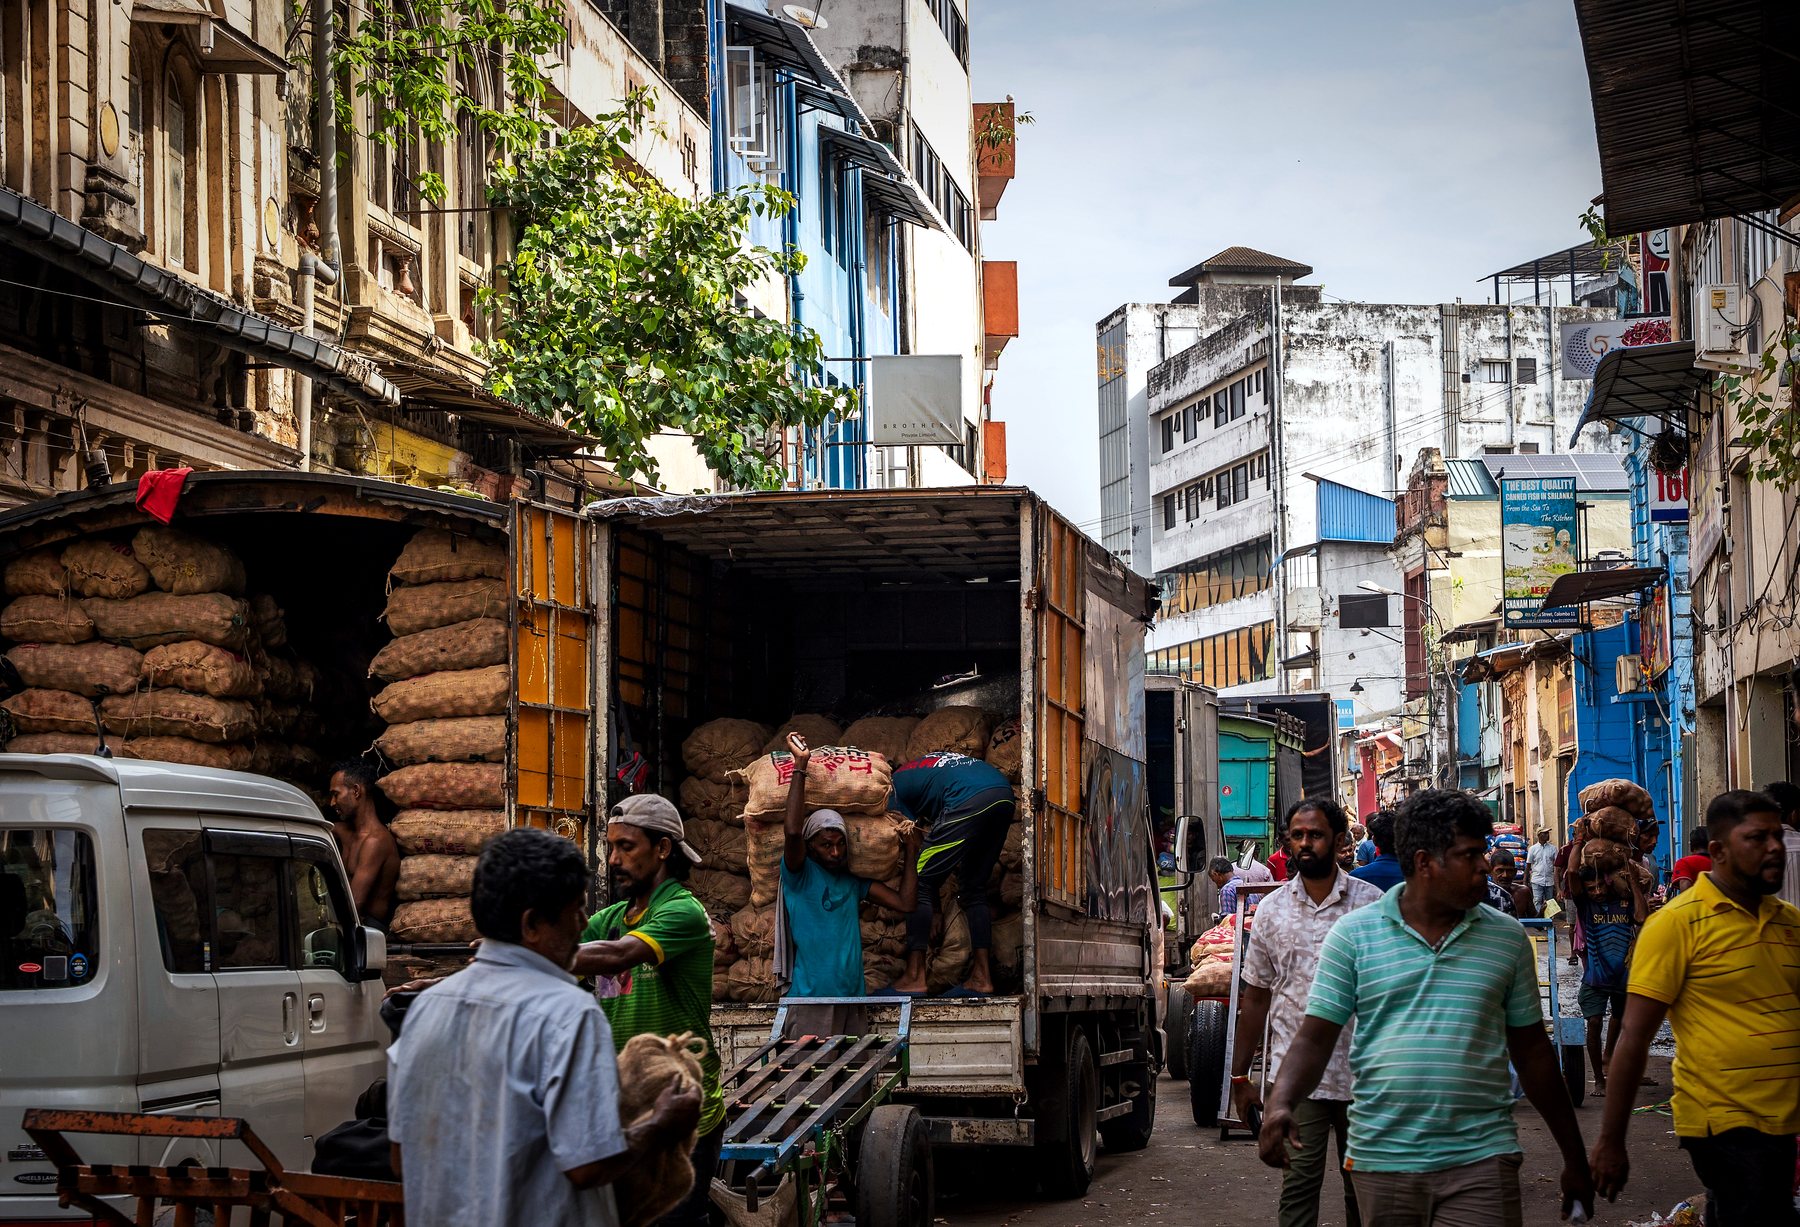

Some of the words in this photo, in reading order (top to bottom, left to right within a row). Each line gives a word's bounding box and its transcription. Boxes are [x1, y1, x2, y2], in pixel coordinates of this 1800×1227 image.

[1506, 480, 1521, 491] THE
[1521, 480, 1540, 490] BEST
[1541, 479, 1574, 491] QUALITY
[1528, 492, 1540, 500] FISH
[1541, 492, 1547, 500] IN
[1505, 504, 1520, 512] From
[1531, 504, 1541, 512] Sea
[1542, 503, 1550, 511] To
[1541, 513, 1551, 522] The
[1552, 513, 1574, 521] Kitchen
[1593, 913, 1606, 924] SRI
